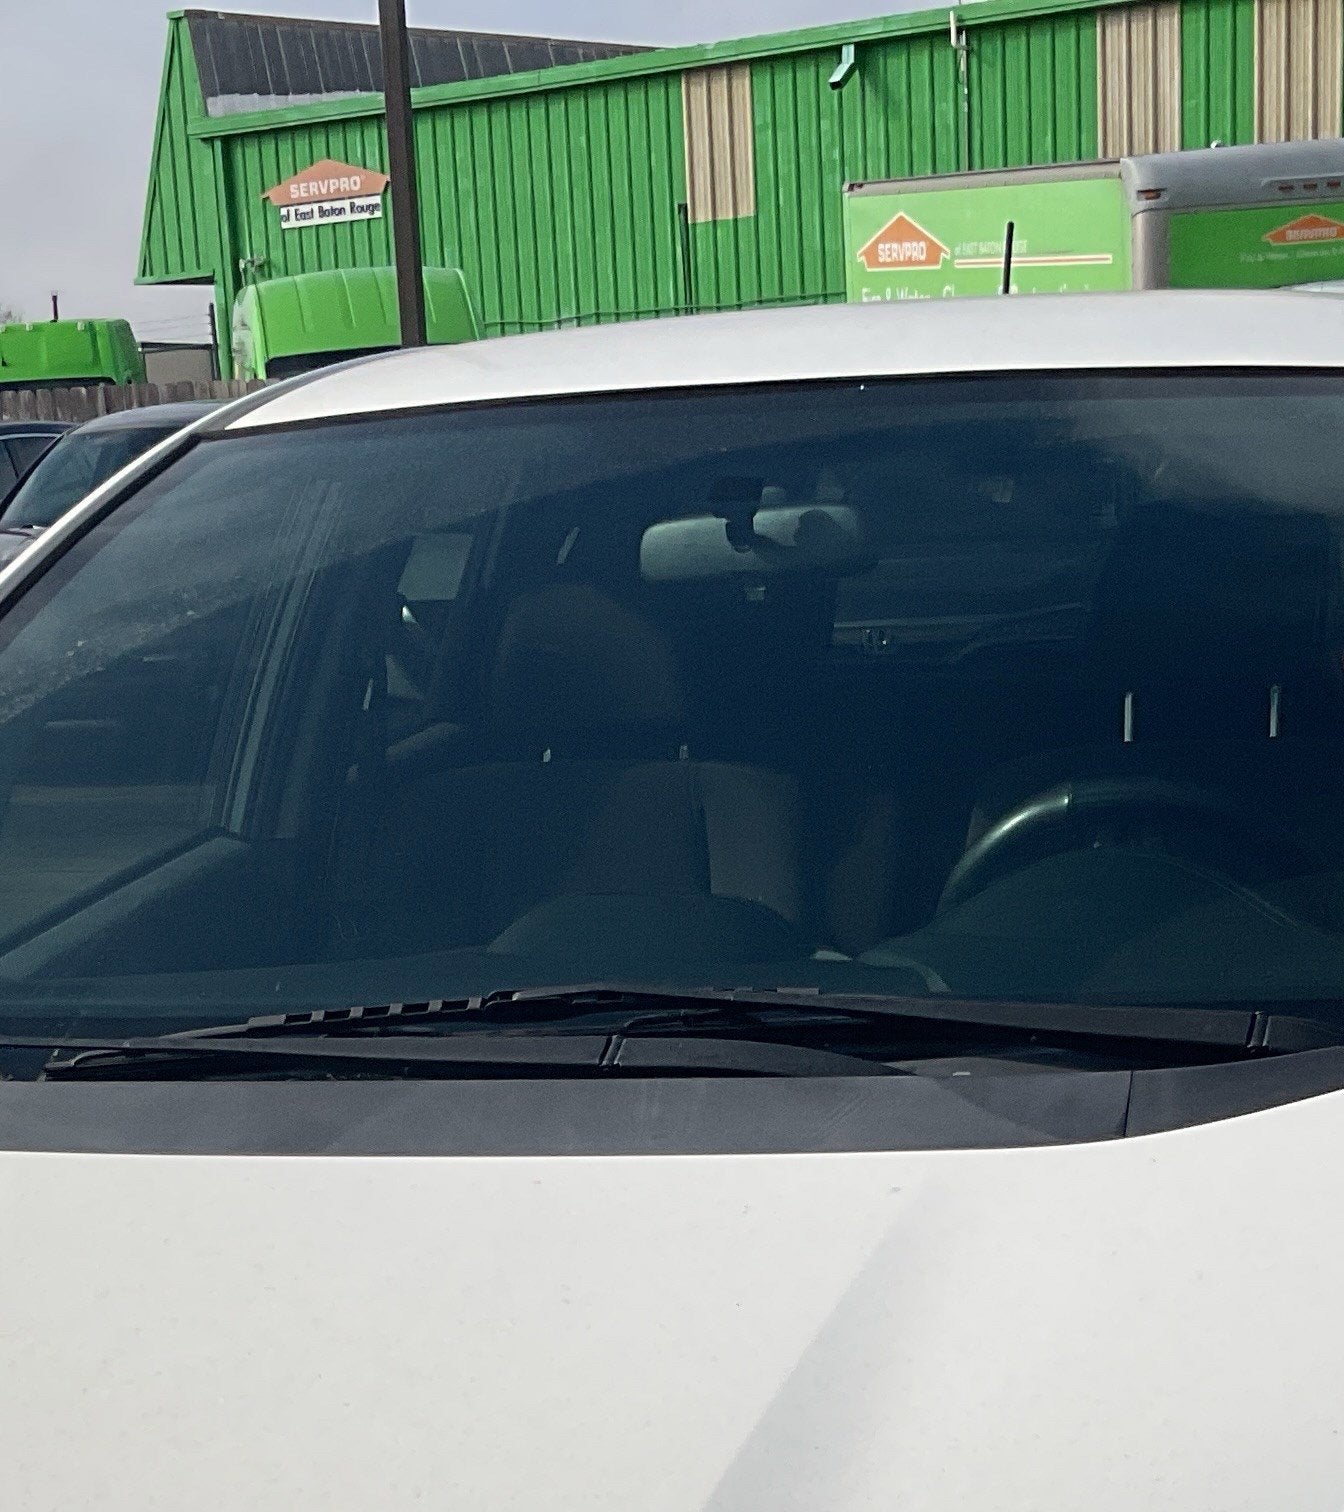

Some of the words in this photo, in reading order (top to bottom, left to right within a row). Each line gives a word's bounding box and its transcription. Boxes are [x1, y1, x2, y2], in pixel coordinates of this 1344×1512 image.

[289, 175, 361, 199] SERVPRO
[294, 207, 314, 221] East
[318, 205, 346, 218] Baton
[349, 201, 381, 216] Rouge
[877, 241, 927, 263] SERVPRO
